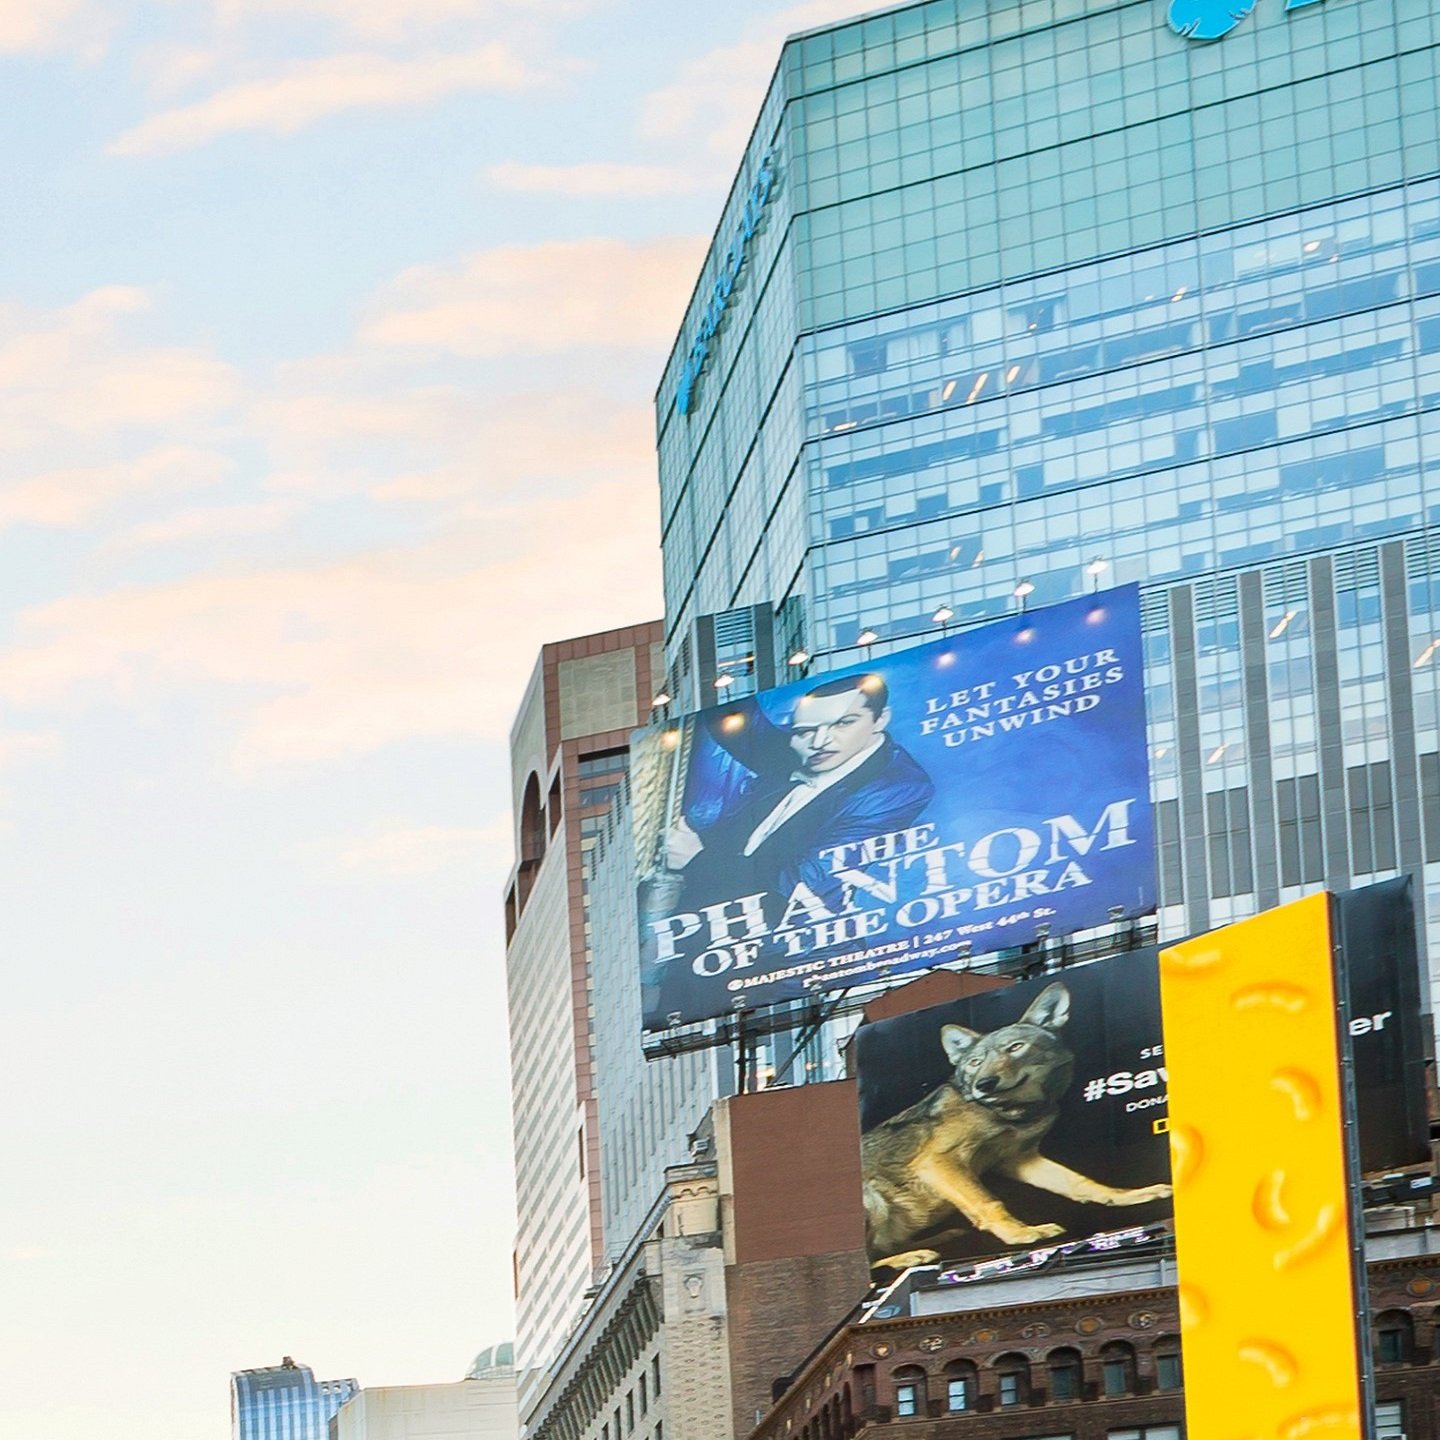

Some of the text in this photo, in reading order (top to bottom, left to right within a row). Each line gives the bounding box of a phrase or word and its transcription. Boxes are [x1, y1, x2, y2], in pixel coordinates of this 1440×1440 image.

[920, 666, 1124, 735] FANTASIES
[926, 647, 1121, 714] LET YOUR
[943, 695, 1101, 748] UNWIND
[819, 822, 936, 873] THE
[648, 799, 1136, 964] PHANTOM
[692, 859, 1093, 978] OF THE OPERA
[829, 938, 910, 971] THEATRE
[922, 930, 953, 949] 247
[957, 918, 992, 941] West
